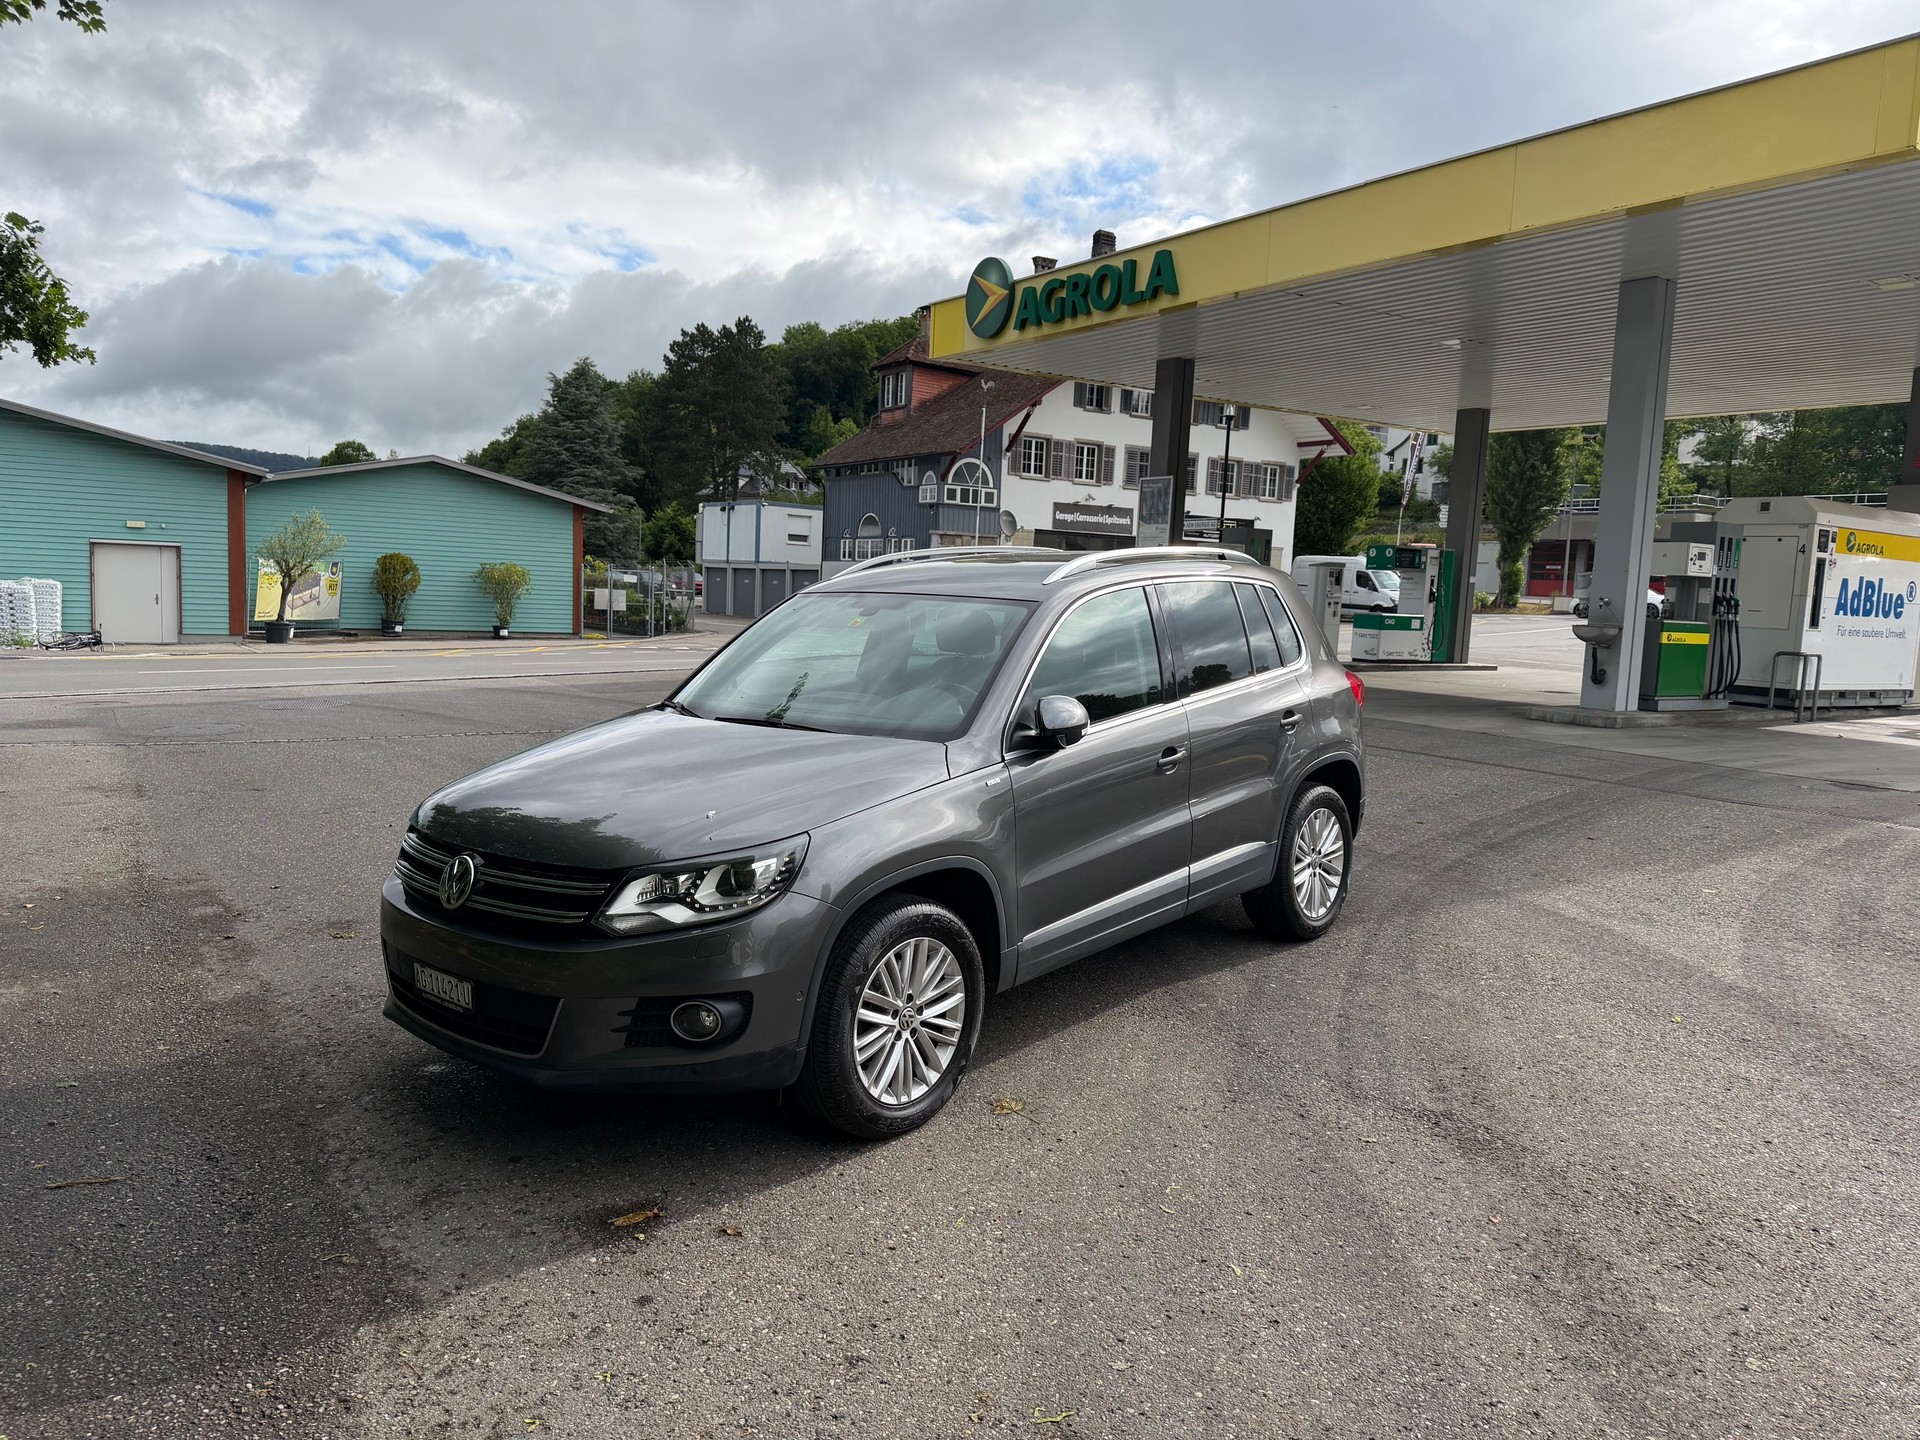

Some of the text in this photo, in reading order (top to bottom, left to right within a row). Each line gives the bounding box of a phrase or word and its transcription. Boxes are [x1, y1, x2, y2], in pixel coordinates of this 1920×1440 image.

[1013, 249, 1179, 331] AGROLA
[1055, 510, 1074, 522] Garage
[1799, 543, 1806, 555] 4
[1855, 542, 1885, 556] AGROLA
[1693, 554, 1698, 565] 2
[1836, 624, 1847, 637] Für
[1848, 625, 1860, 637] eine
[1861, 626, 1884, 639] saubere
